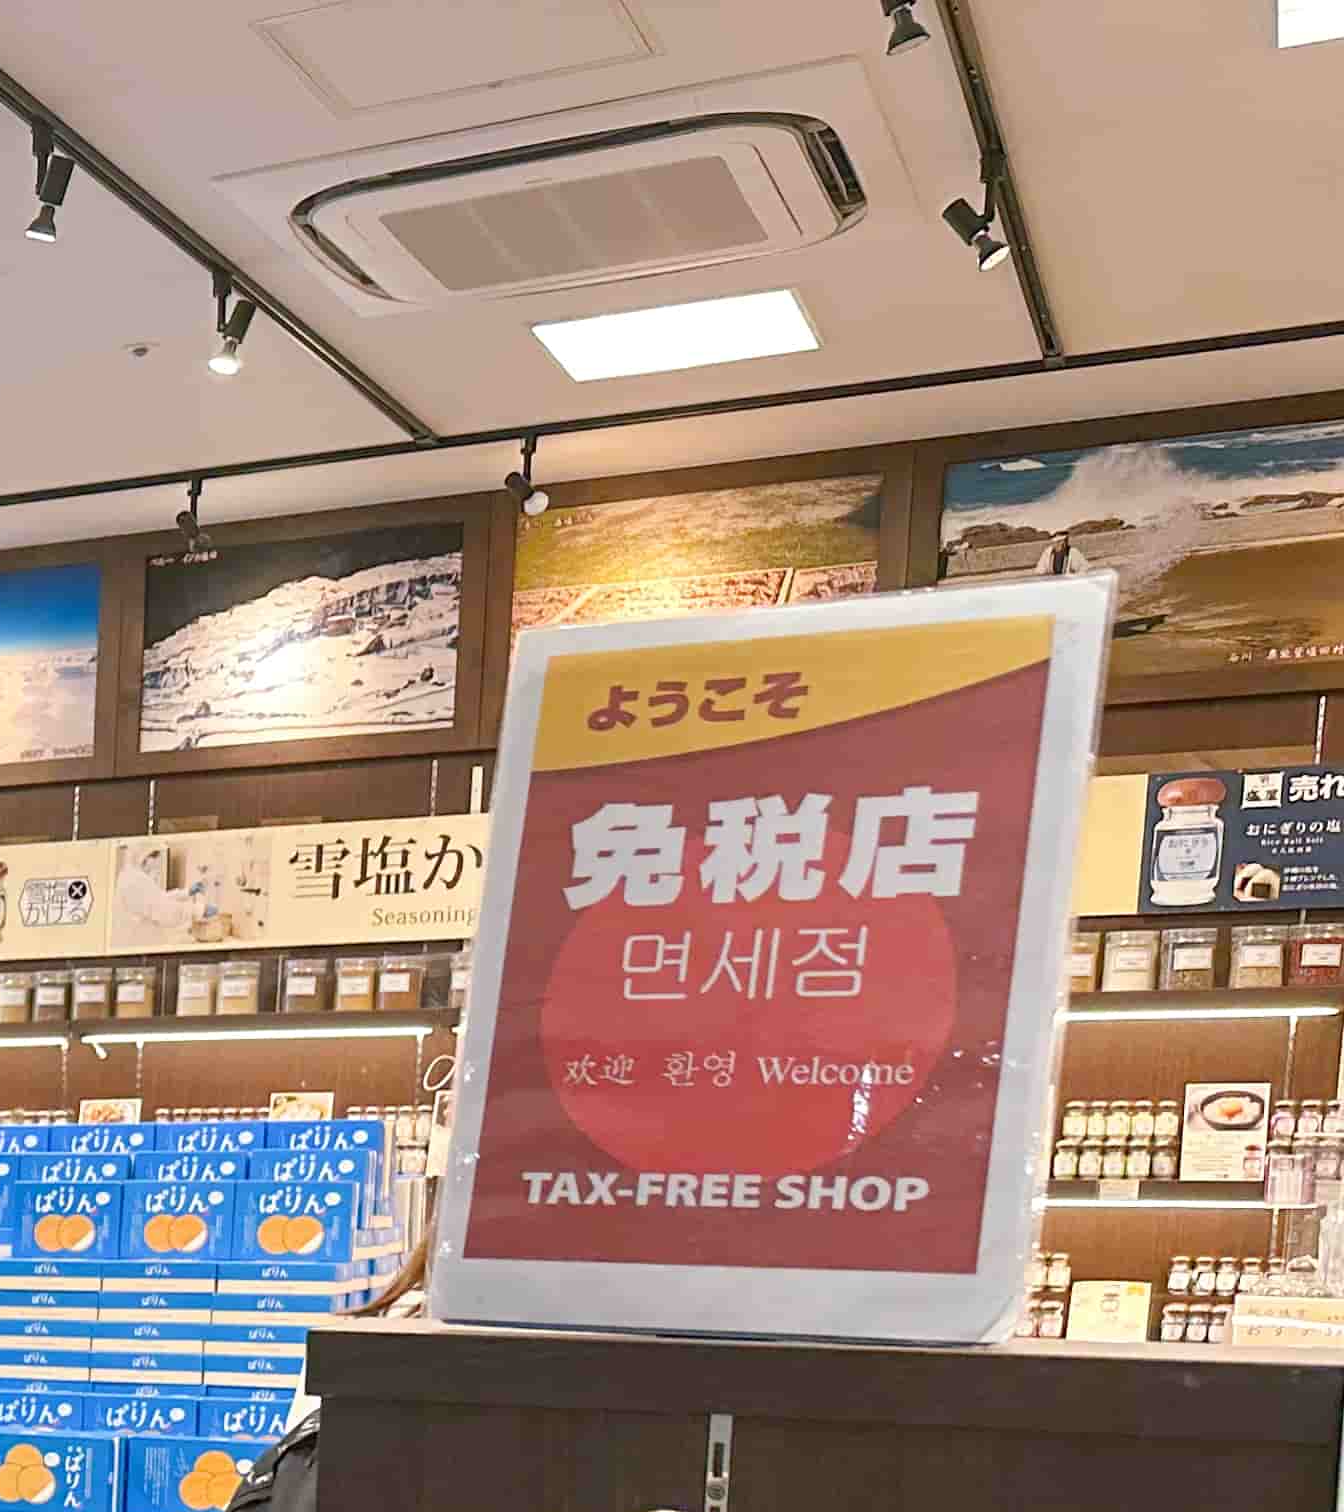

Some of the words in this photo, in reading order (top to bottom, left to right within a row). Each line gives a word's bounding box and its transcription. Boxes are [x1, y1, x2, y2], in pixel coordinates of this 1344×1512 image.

[587, 672, 809, 732] ようこそ
[289, 834, 483, 899] 雪塩か
[561, 786, 980, 911] 免税店
[622, 923, 869, 1001] 면세점
[563, 1053, 635, 1087] 欢迎
[663, 1051, 736, 1089] 환영
[759, 1053, 915, 1087] Welcome
[521, 1170, 761, 1208] TAX-FREE
[775, 1175, 930, 1213] SHOP
